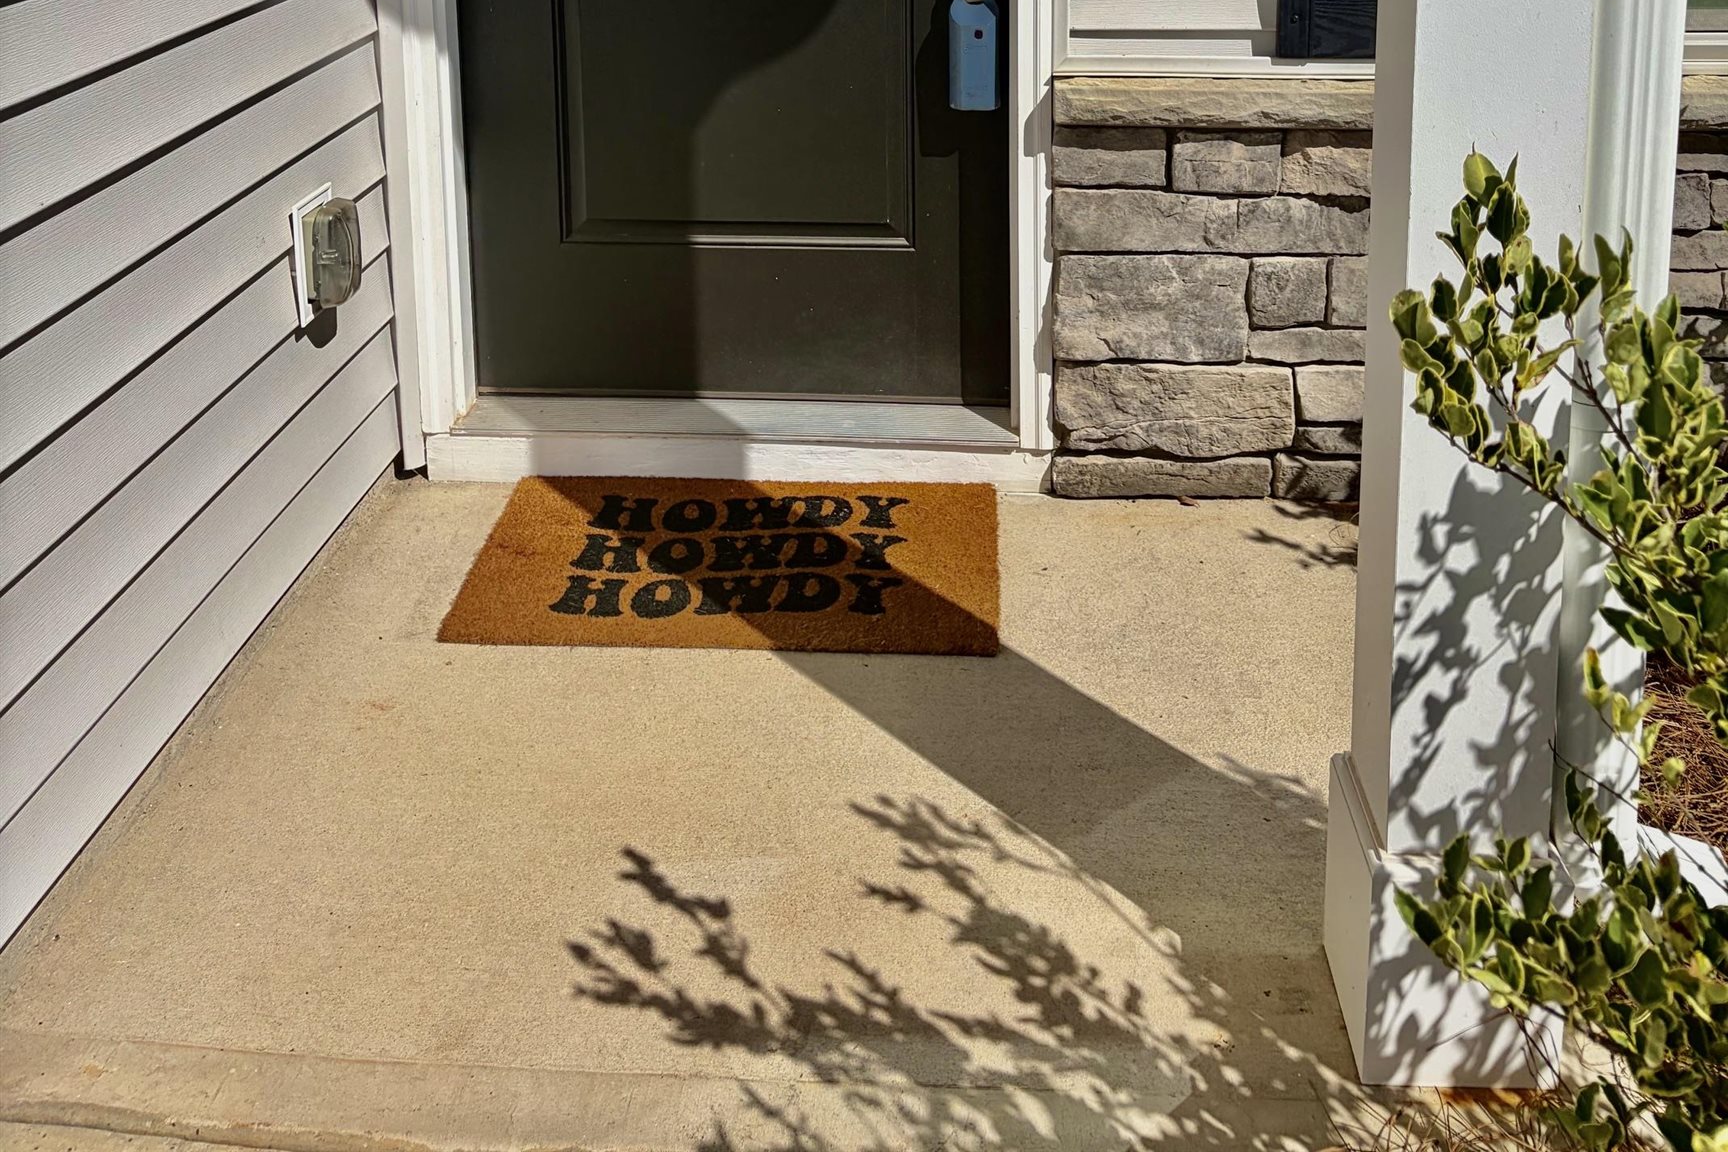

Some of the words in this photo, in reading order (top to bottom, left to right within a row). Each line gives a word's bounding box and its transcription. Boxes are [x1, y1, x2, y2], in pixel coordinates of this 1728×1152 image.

[588, 494, 910, 532] HOWDY
[569, 533, 908, 574] HOWDY
[549, 574, 904, 618] HOWDY
